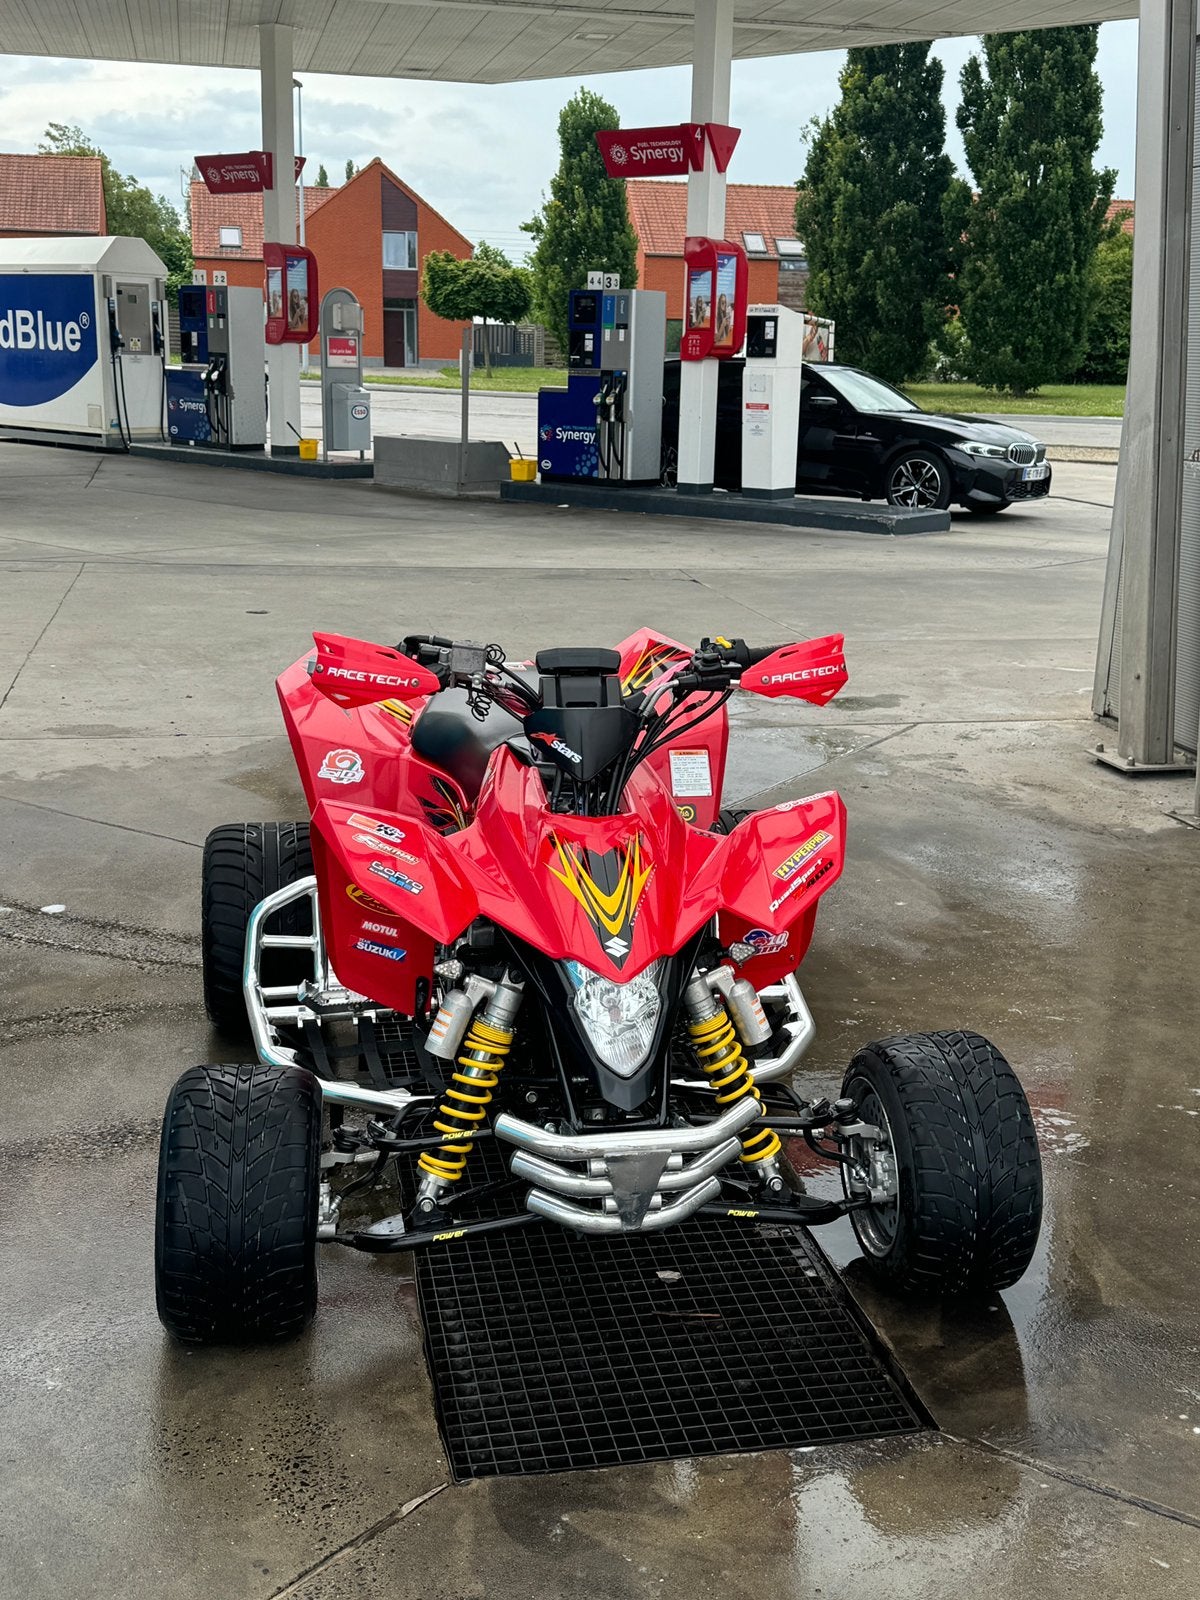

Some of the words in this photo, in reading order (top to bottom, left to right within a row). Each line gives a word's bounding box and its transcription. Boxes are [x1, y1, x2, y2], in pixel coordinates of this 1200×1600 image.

[694, 127, 702, 141] 4
[261, 154, 267, 166] 1
[630, 146, 684, 164] Synergy
[294, 159, 300, 171] 2
[220, 168, 260, 183] Synergy
[605, 276, 612, 289] 3
[556, 427, 596, 445] Synergy
[327, 666, 409, 687] RACETECH
[771, 665, 840, 685] RACETECH
[777, 833, 827, 877] HYPERPRO
[371, 860, 424, 890] GoPro
[361, 920, 399, 938] MOTUL
[356, 941, 398, 960] SUZUKI
